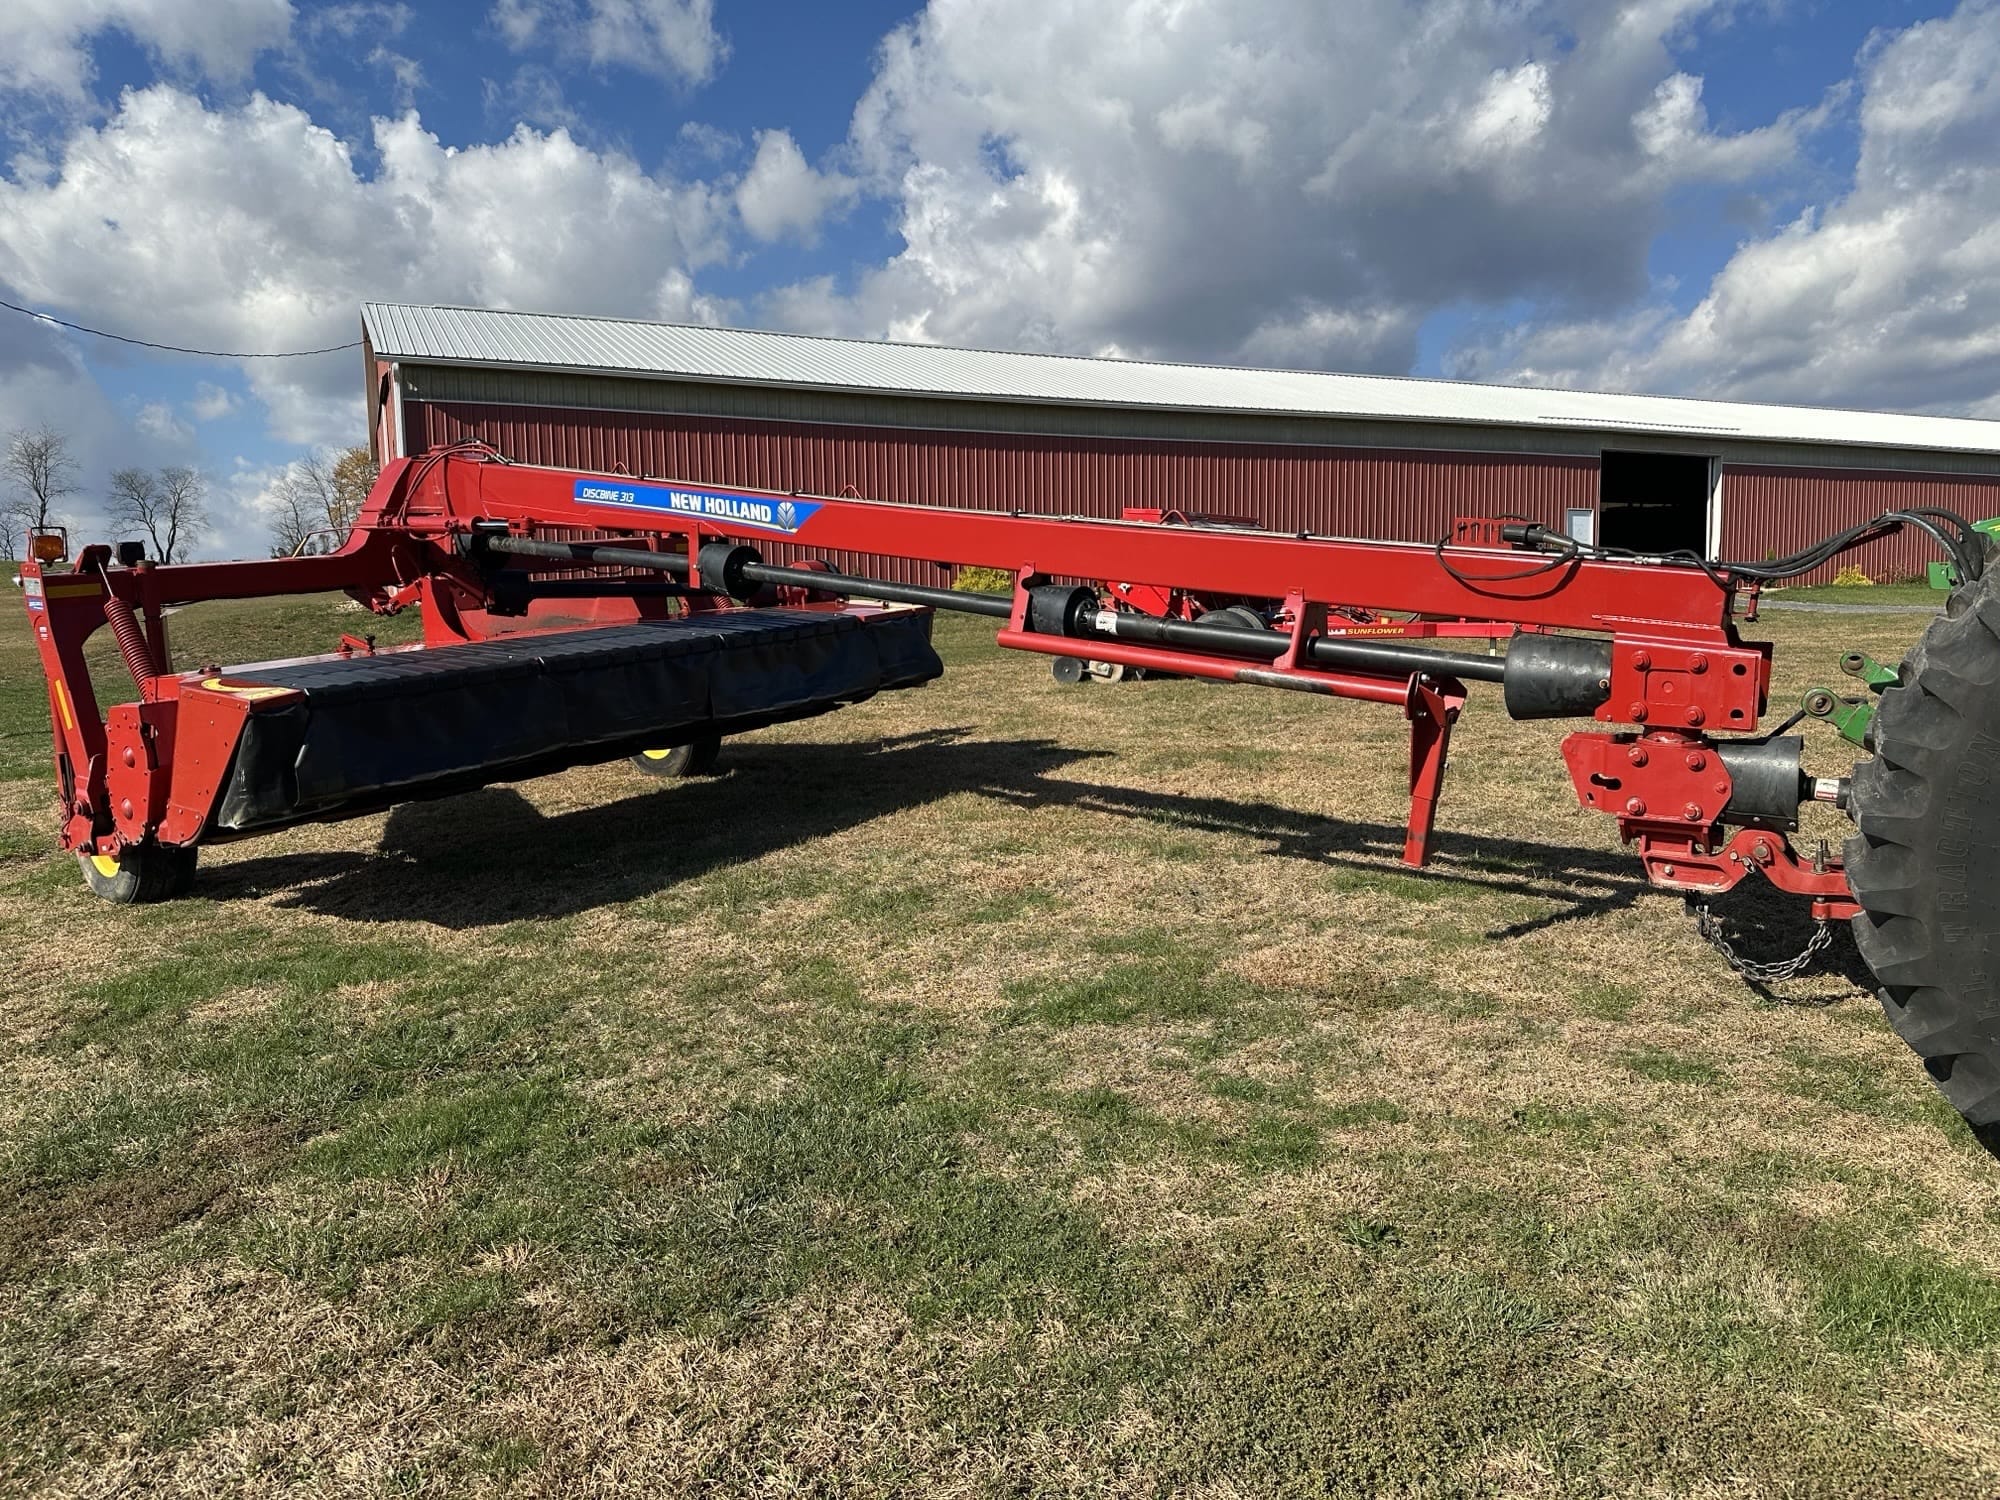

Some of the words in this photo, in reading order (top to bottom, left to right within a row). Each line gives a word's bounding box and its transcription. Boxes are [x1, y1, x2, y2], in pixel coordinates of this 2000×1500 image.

[582, 487, 619, 502] DISCBINE
[619, 492, 635, 503] 313
[670, 491, 702, 512] NEW
[704, 498, 772, 523] HOLLAND
[1347, 627, 1405, 636] SUNFLOWER
